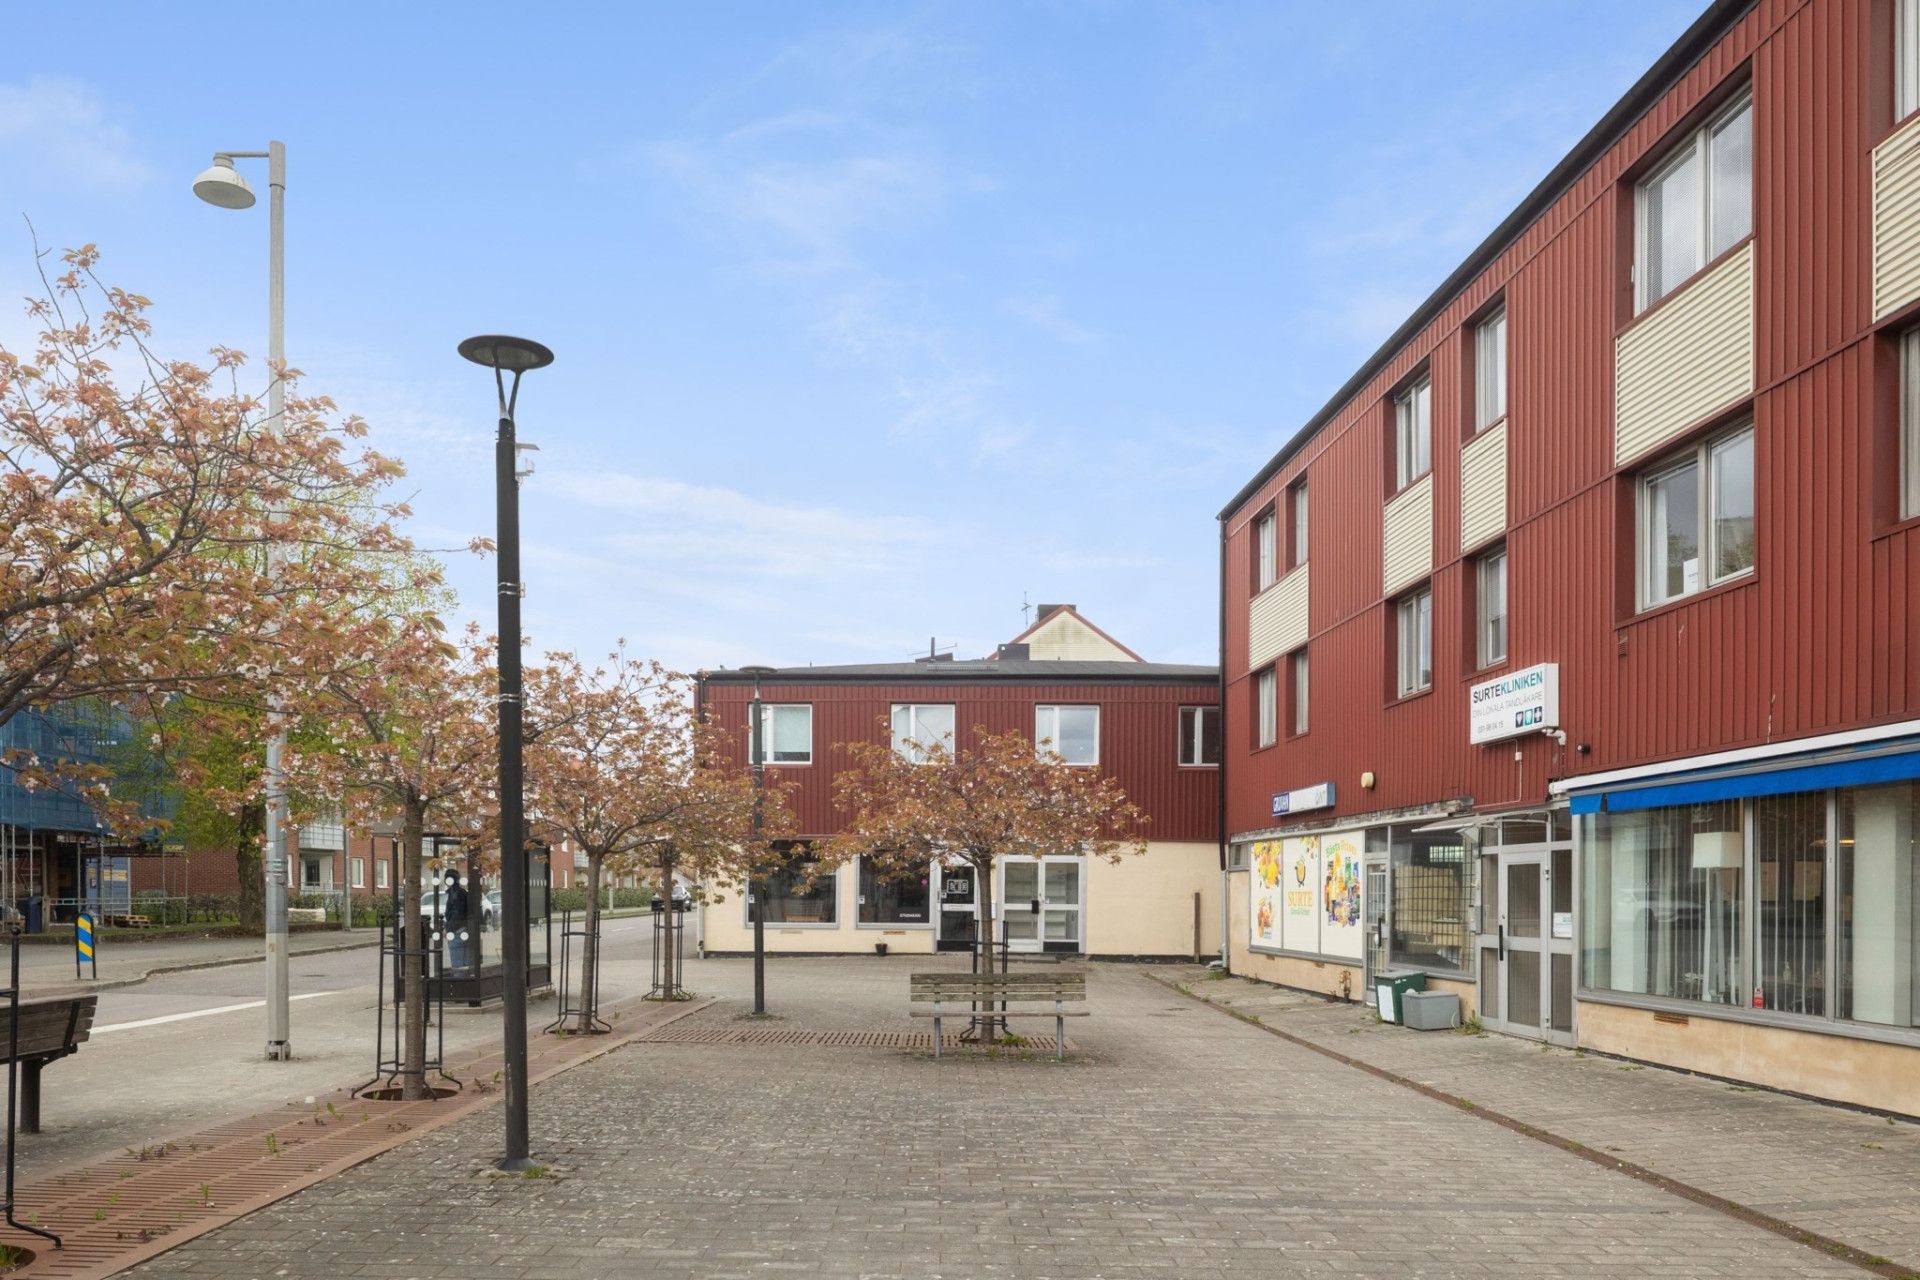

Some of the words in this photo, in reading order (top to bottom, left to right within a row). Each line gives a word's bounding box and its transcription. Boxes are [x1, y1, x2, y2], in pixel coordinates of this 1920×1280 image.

[1473, 671, 1543, 704] SURTEKLINIKEN
[1483, 703, 1504, 716] LOKALA
[1505, 690, 1543, 709] TANDLÄKARE
[1287, 890, 1313, 907] SURTE
